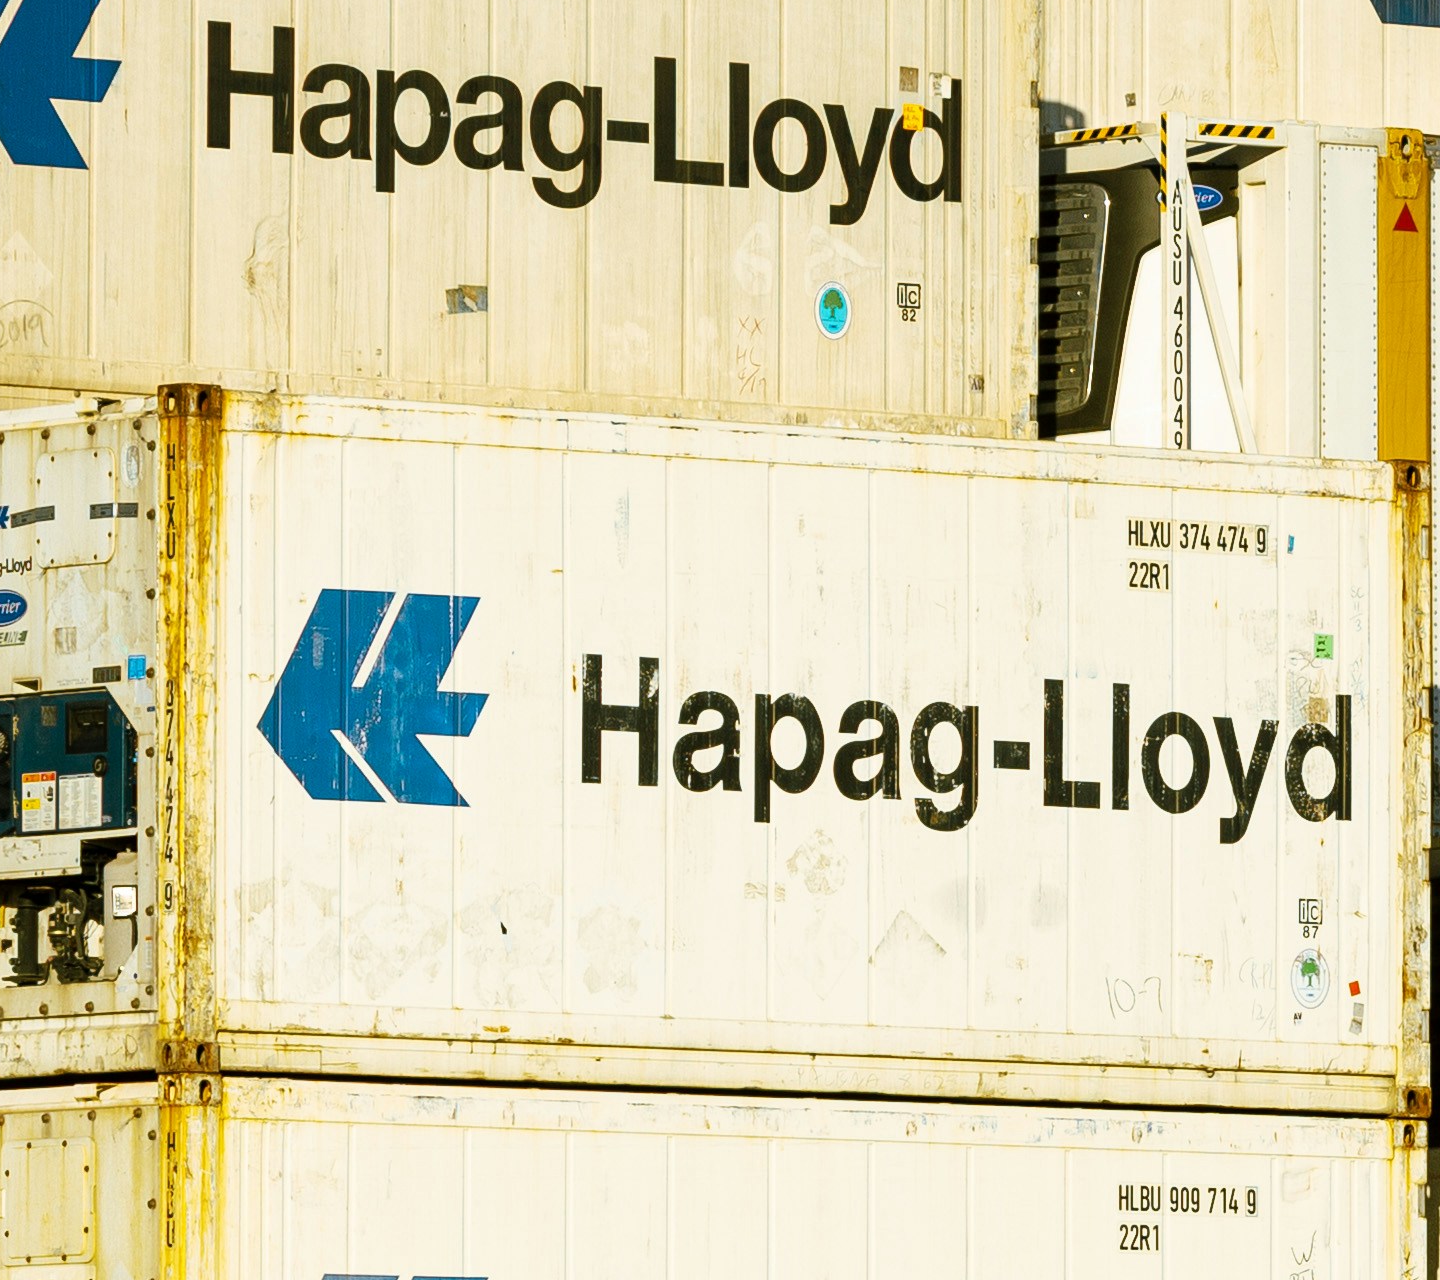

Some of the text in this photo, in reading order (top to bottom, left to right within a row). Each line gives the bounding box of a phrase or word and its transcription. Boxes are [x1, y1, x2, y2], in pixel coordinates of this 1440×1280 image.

[206, 20, 962, 226] Hapag-Lloyd
[901, 309, 917, 322] 82
[1172, 178, 1184, 450] AUSU 460049
[1128, 520, 1266, 553] HLXU 374 474 9
[1129, 562, 1170, 590] 22R1
[581, 653, 1352, 845] Hapag-Lloyd
[1302, 926, 1319, 939] 87
[1118, 1184, 1256, 1215] HLBU 909 714 9
[1119, 1224, 1160, 1251] 22R1
